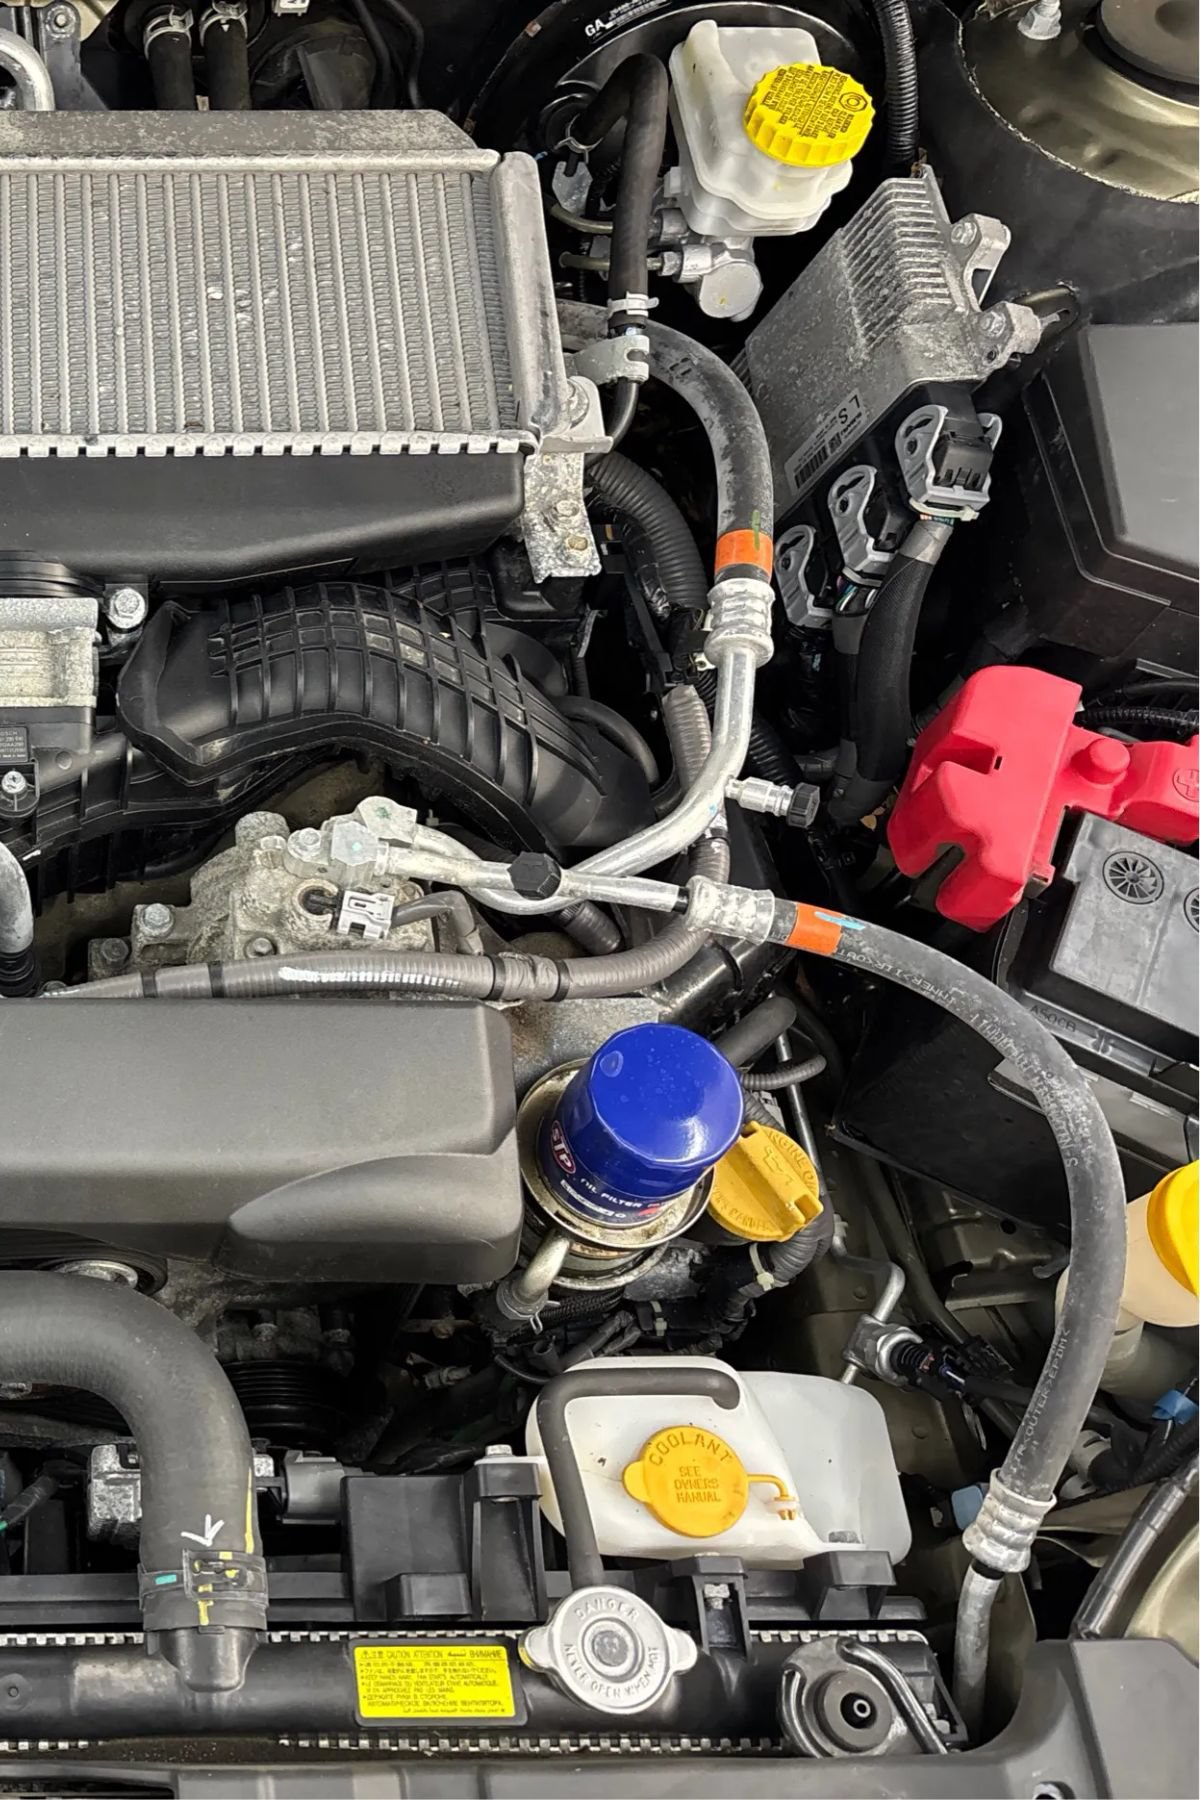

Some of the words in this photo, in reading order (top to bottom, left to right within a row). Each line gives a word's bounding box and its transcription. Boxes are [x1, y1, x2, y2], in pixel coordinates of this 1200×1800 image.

[552, 1127, 573, 1168] STP
[600, 1192, 643, 1208] FILTER
[649, 1432, 733, 1466] COOLANT
[679, 1466, 701, 1477] SEE
[676, 1491, 722, 1503] MANUAL
[574, 1598, 640, 1620] DANGER
[563, 1644, 590, 1680] NEVER
[590, 1680, 622, 1697] OPEN
